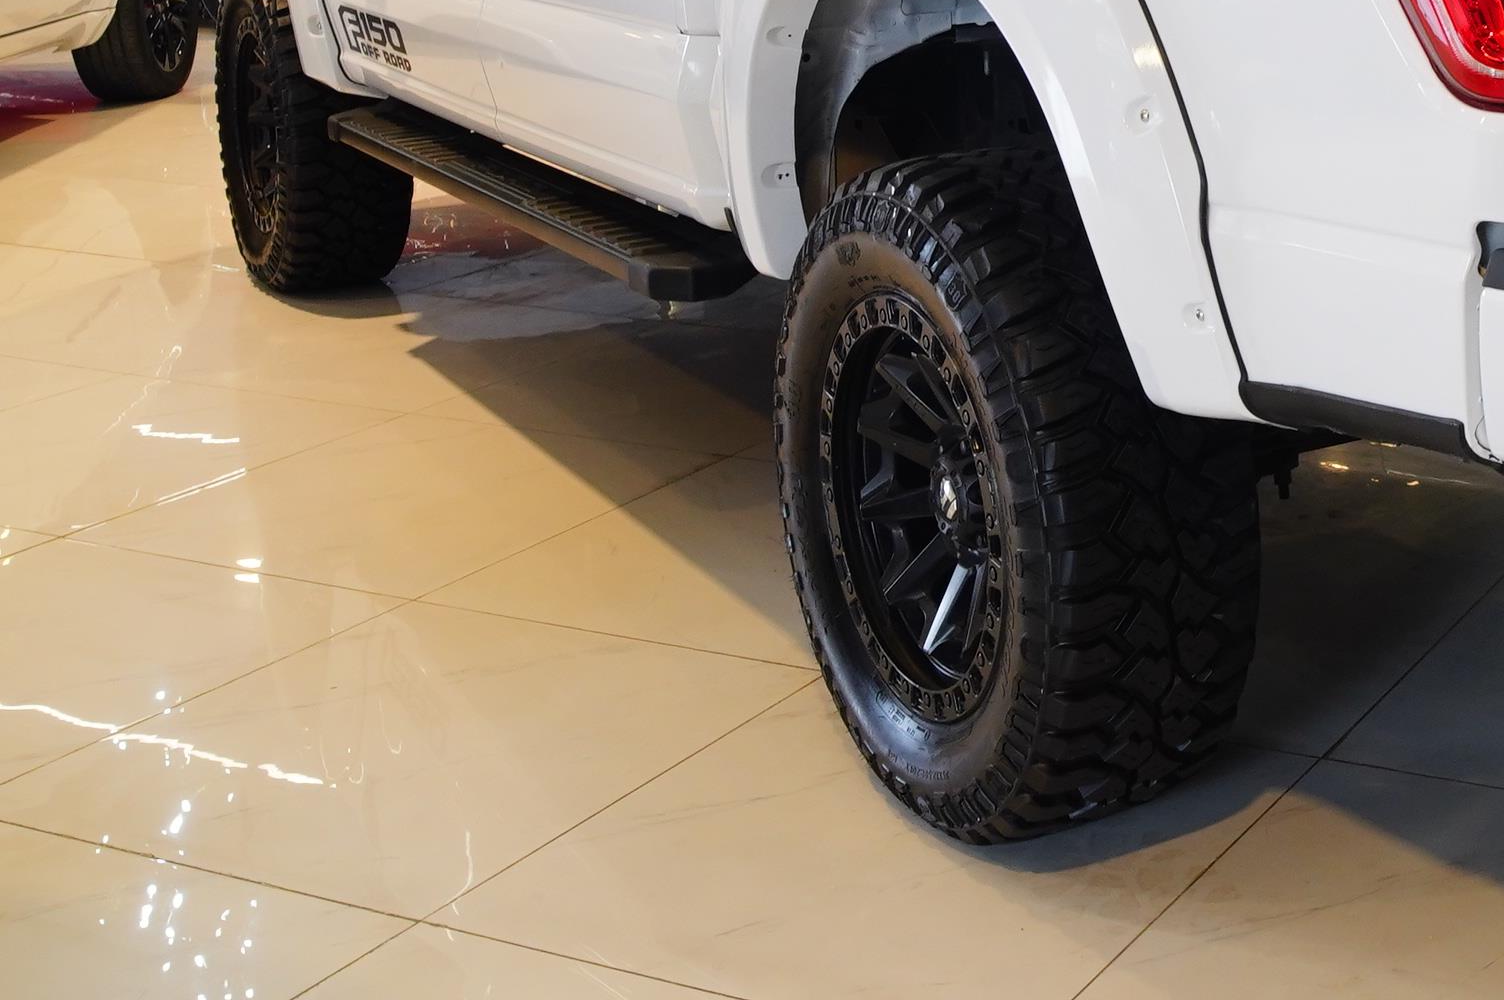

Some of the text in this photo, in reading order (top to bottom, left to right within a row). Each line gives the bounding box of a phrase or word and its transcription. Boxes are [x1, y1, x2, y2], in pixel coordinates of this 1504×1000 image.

[339, 5, 407, 55] F150
[361, 42, 412, 73] OFF ROAD
